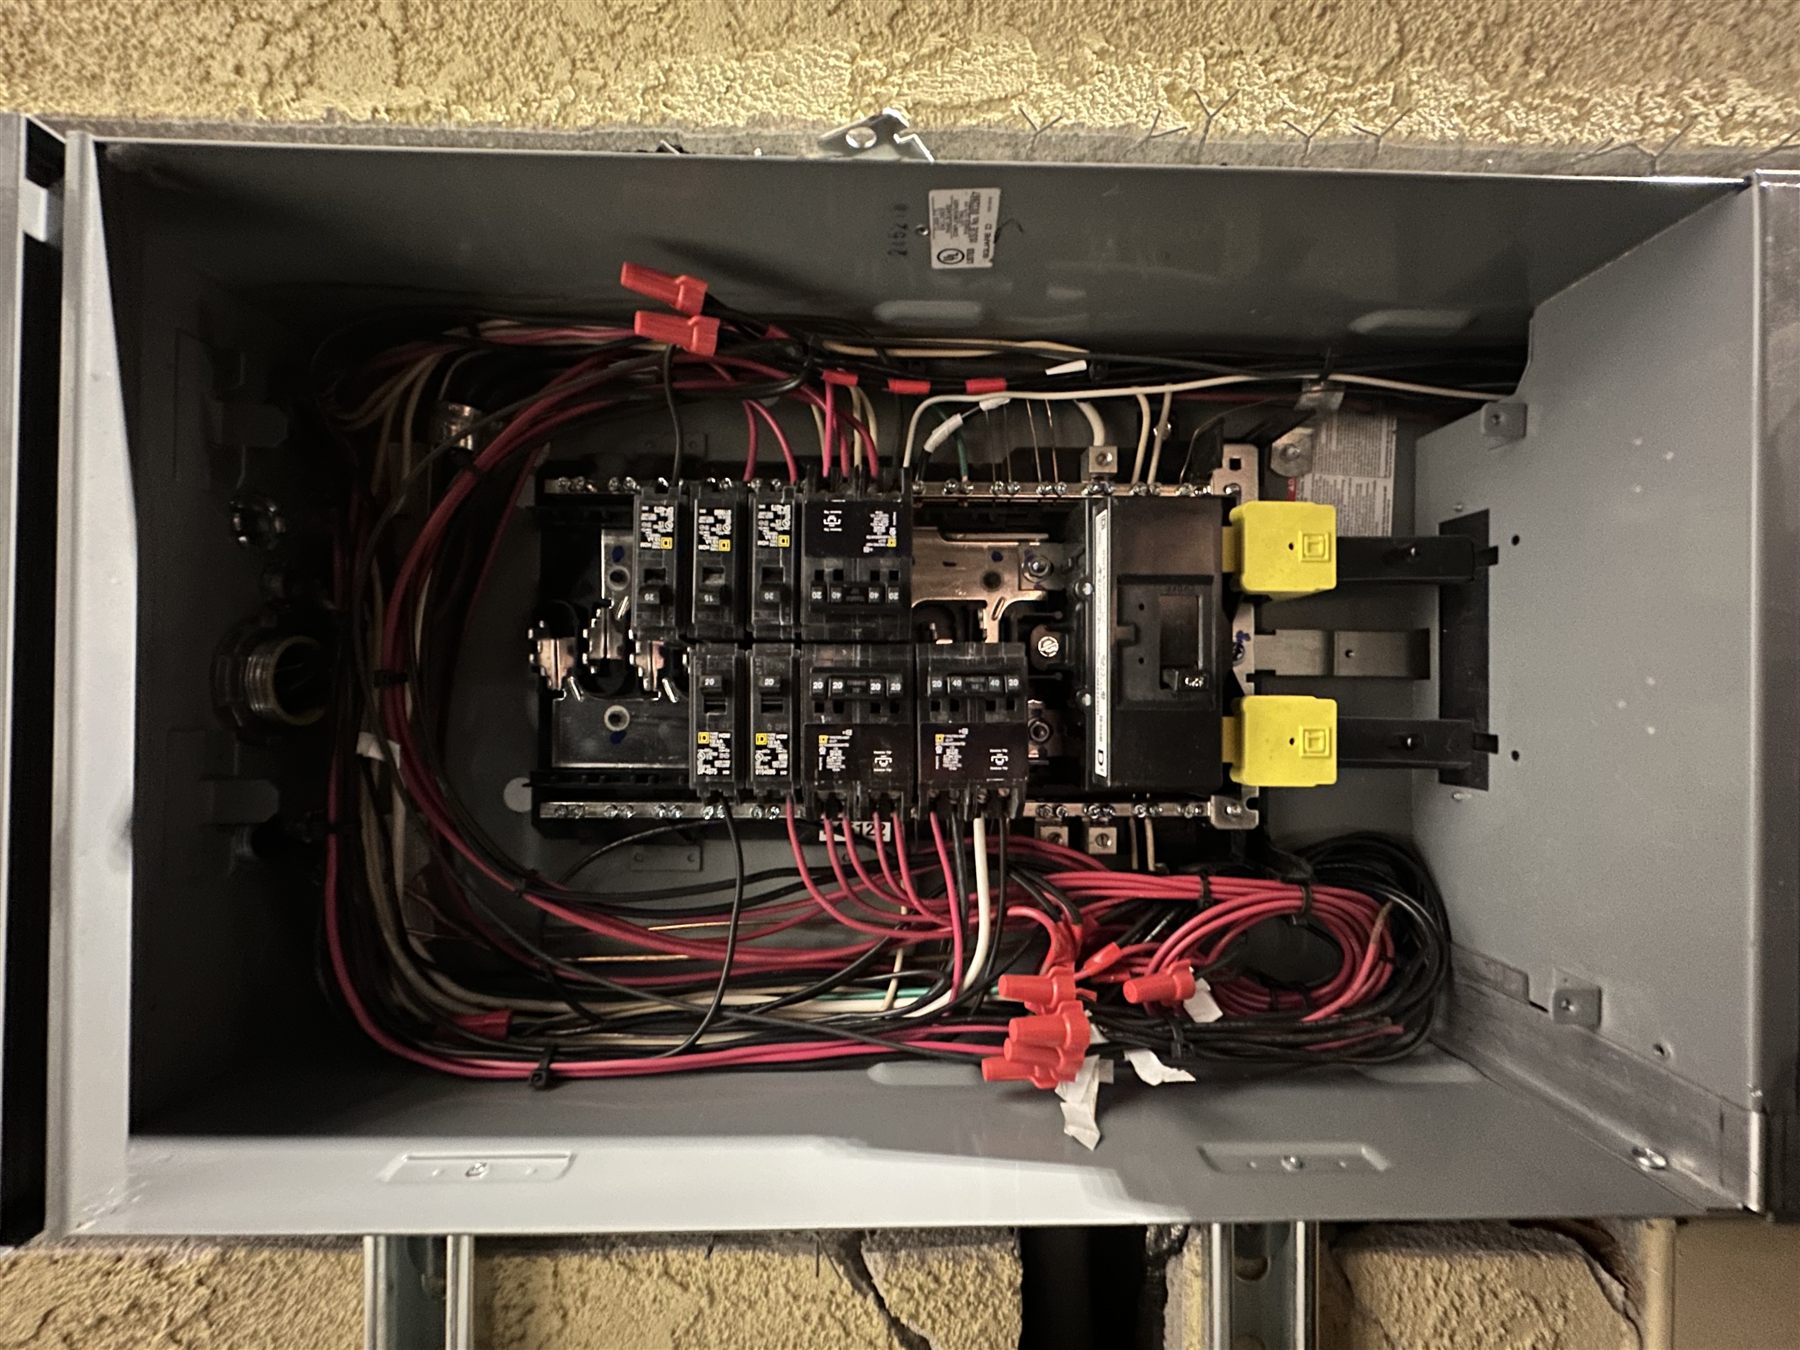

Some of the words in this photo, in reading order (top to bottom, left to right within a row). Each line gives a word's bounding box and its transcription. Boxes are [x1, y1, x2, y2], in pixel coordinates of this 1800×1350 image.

[984, 223, 992, 231] D
[982, 232, 992, 259] SQUARE
[703, 594, 714, 602] 15
[763, 592, 774, 600] 20
[811, 591, 823, 600] 20
[831, 592, 843, 600] 40
[868, 591, 880, 600] 40
[887, 592, 899, 601] 20
[704, 678, 716, 686] 20
[763, 678, 775, 686] 20
[812, 680, 824, 690] 20
[832, 680, 844, 690] 20
[870, 681, 882, 691] 20
[889, 681, 902, 692] 20
[931, 678, 943, 688] 20
[951, 677, 962, 688] 40
[989, 677, 1001, 688] 40
[1007, 677, 1019, 688] 20
